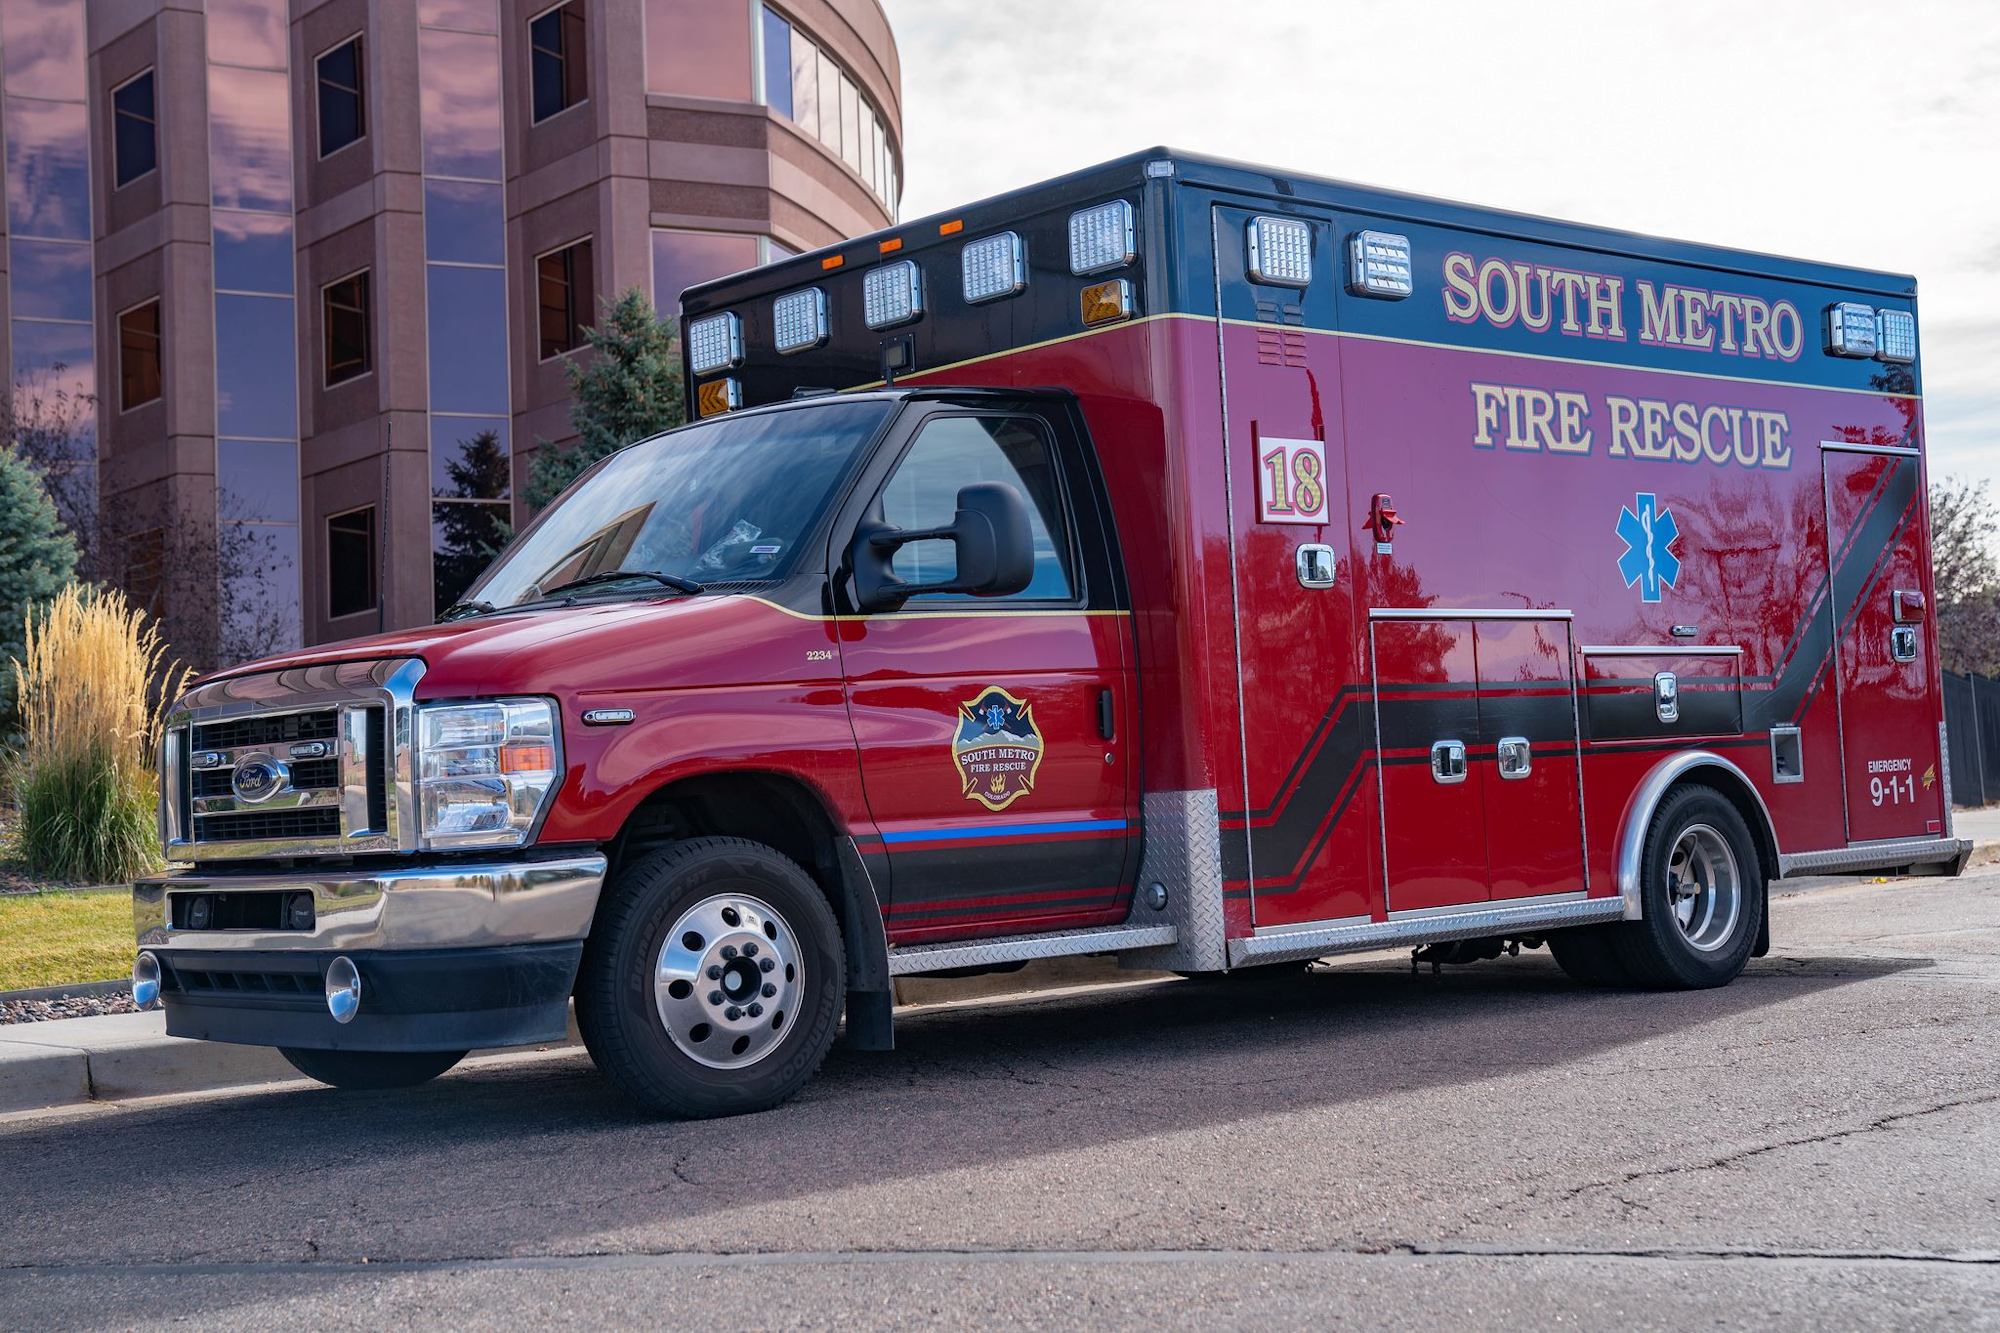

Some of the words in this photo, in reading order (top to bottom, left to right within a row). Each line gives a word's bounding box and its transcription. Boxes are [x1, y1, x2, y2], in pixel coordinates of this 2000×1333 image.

[1442, 252, 1627, 342] SOUTH
[1637, 279, 1804, 363] METRO
[1469, 381, 1593, 454] FIRE
[1605, 394, 1793, 470] RESCUE
[1262, 446, 1325, 517] 18
[806, 650, 832, 661] 2234
[961, 749, 996, 766] SOUTH
[998, 748, 1035, 761] METRO
[1868, 758, 1911, 773] EMERGENCY
[970, 763, 991, 773] FIRE
[993, 762, 1026, 772] RESCUE
[239, 768, 263, 789] Ford
[984, 790, 1011, 801] COLORADO
[1870, 774, 1915, 807] 9-1-1
